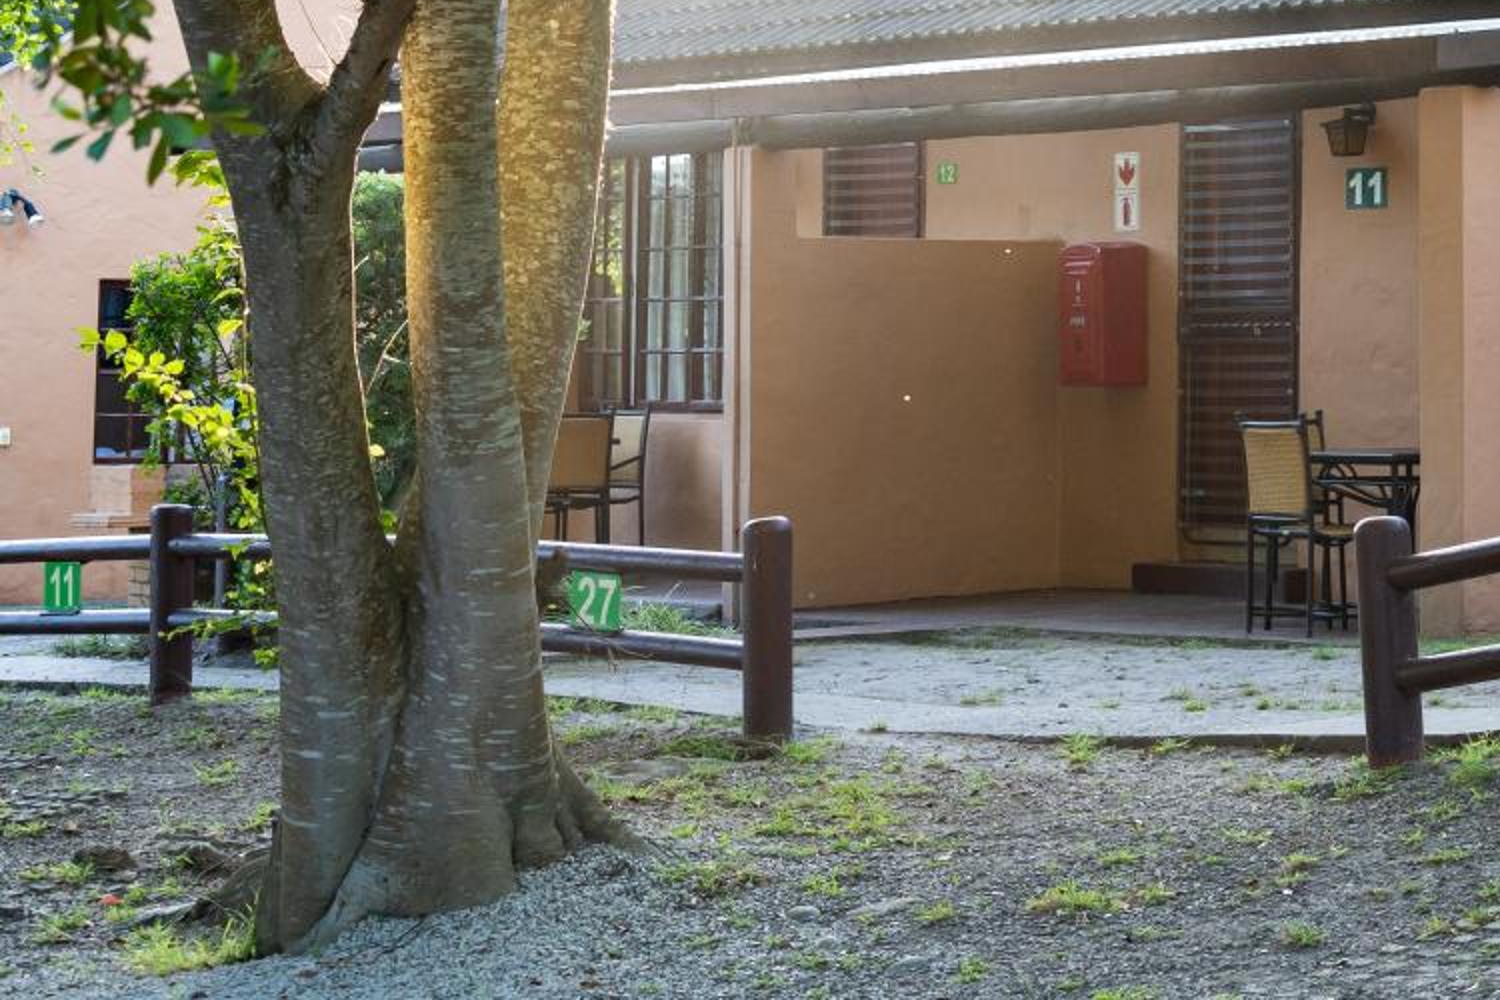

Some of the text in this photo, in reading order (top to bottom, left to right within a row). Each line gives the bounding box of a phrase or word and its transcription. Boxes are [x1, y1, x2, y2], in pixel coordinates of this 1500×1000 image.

[1349, 171, 1382, 206] 11
[50, 566, 74, 607] 11
[577, 577, 617, 627] 27
